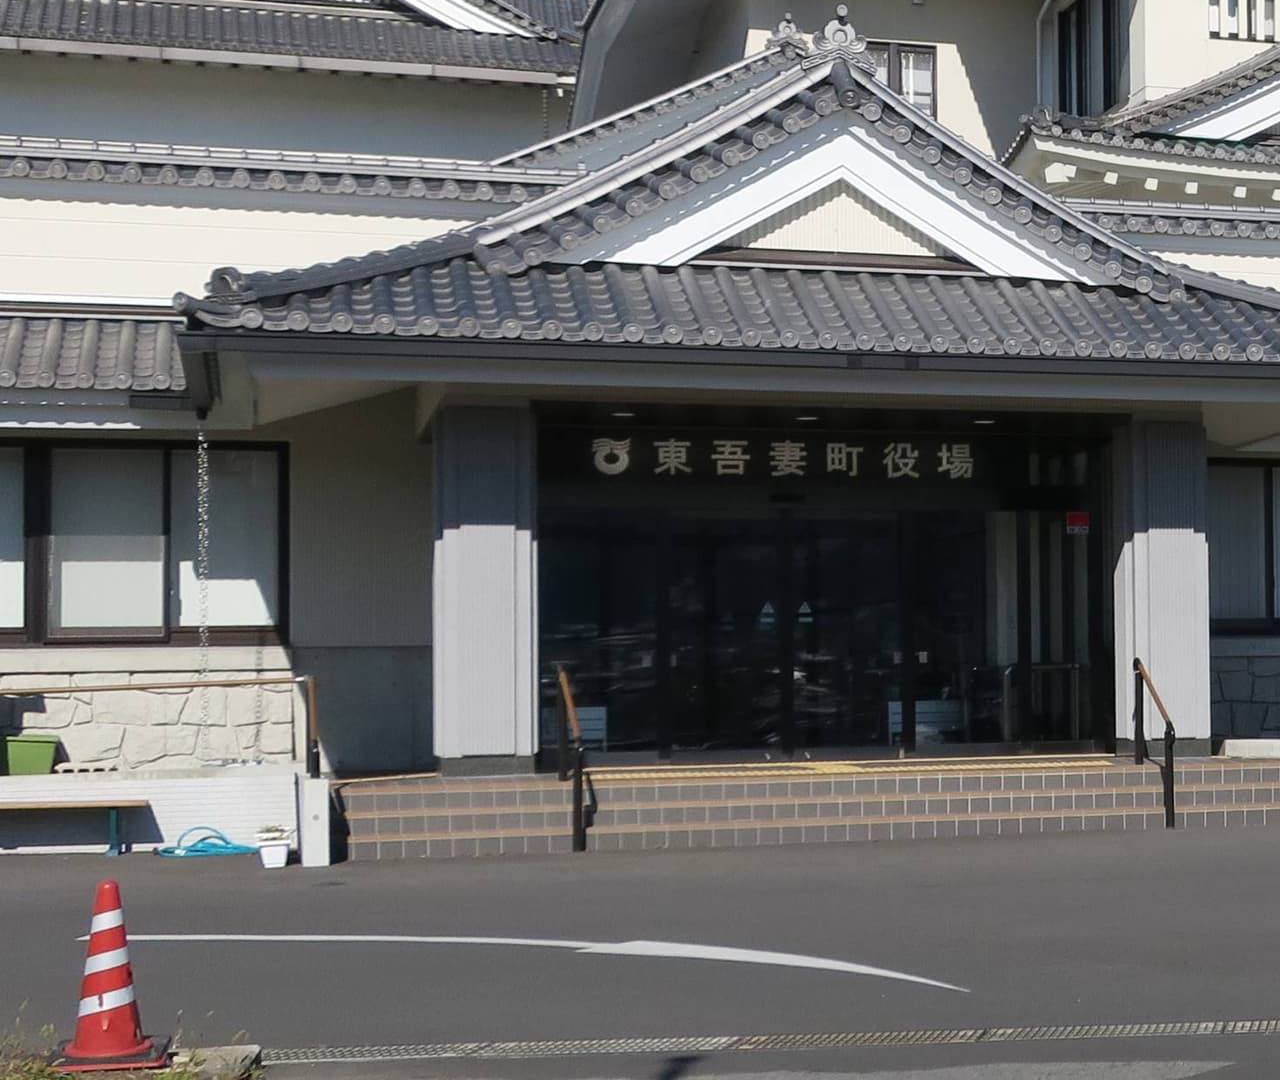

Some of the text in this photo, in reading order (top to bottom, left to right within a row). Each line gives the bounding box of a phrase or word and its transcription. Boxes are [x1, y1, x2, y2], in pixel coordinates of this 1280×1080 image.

[653, 438, 973, 479] 東吾妻町役場
